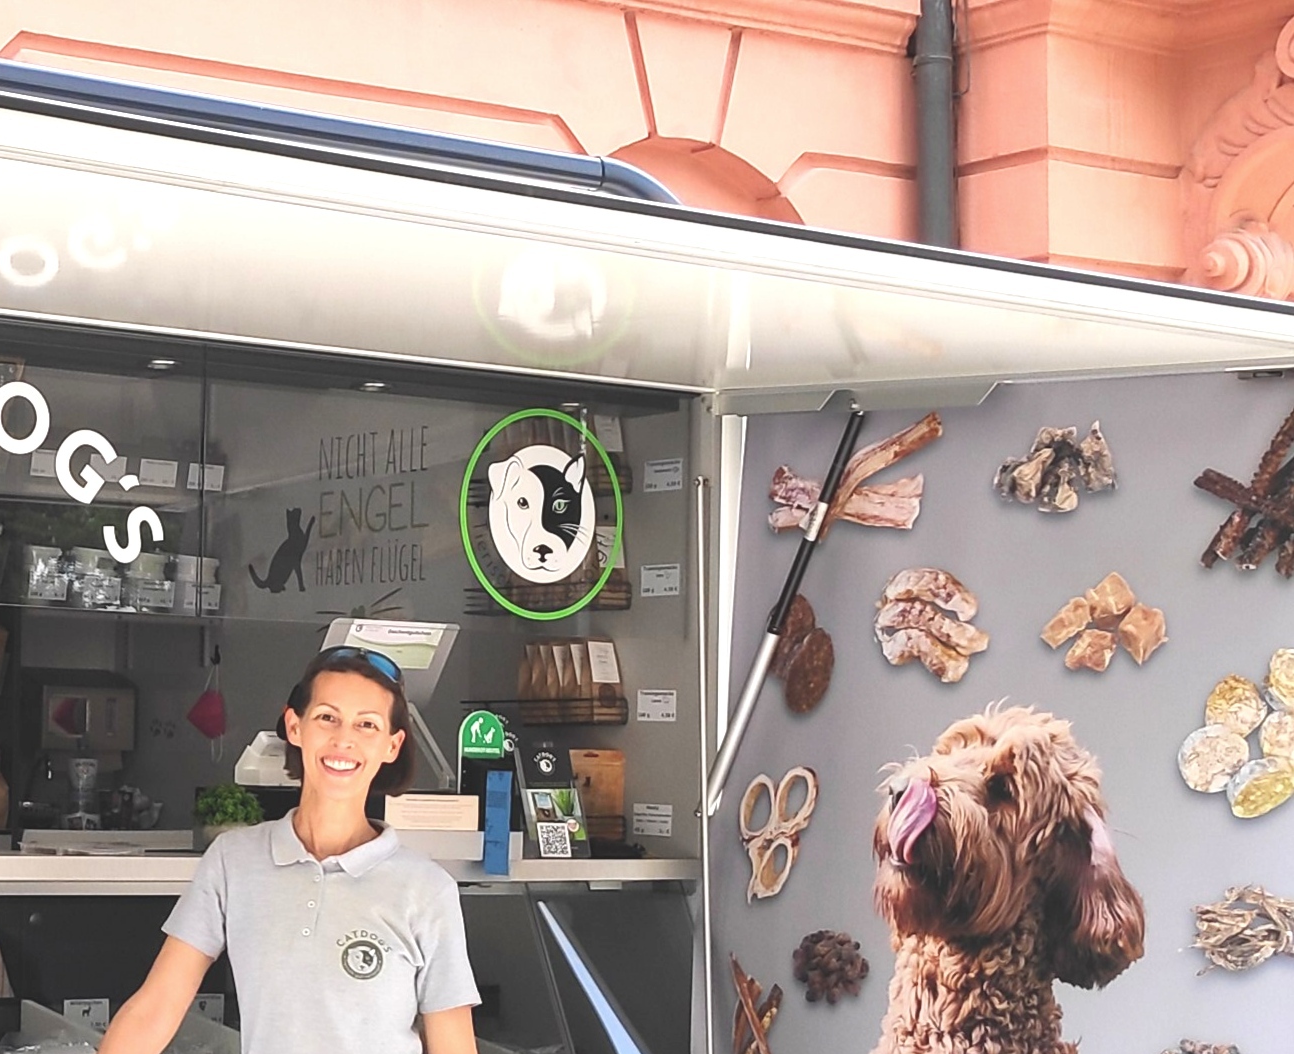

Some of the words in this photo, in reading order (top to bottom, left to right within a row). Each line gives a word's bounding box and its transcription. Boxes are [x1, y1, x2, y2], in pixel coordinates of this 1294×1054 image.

[318, 430, 379, 481] NICHT
[385, 425, 429, 474] ALLE
[317, 481, 430, 539] ENGEL
[315, 546, 365, 587] HABEN
[370, 539, 427, 584] FLÜGEL
